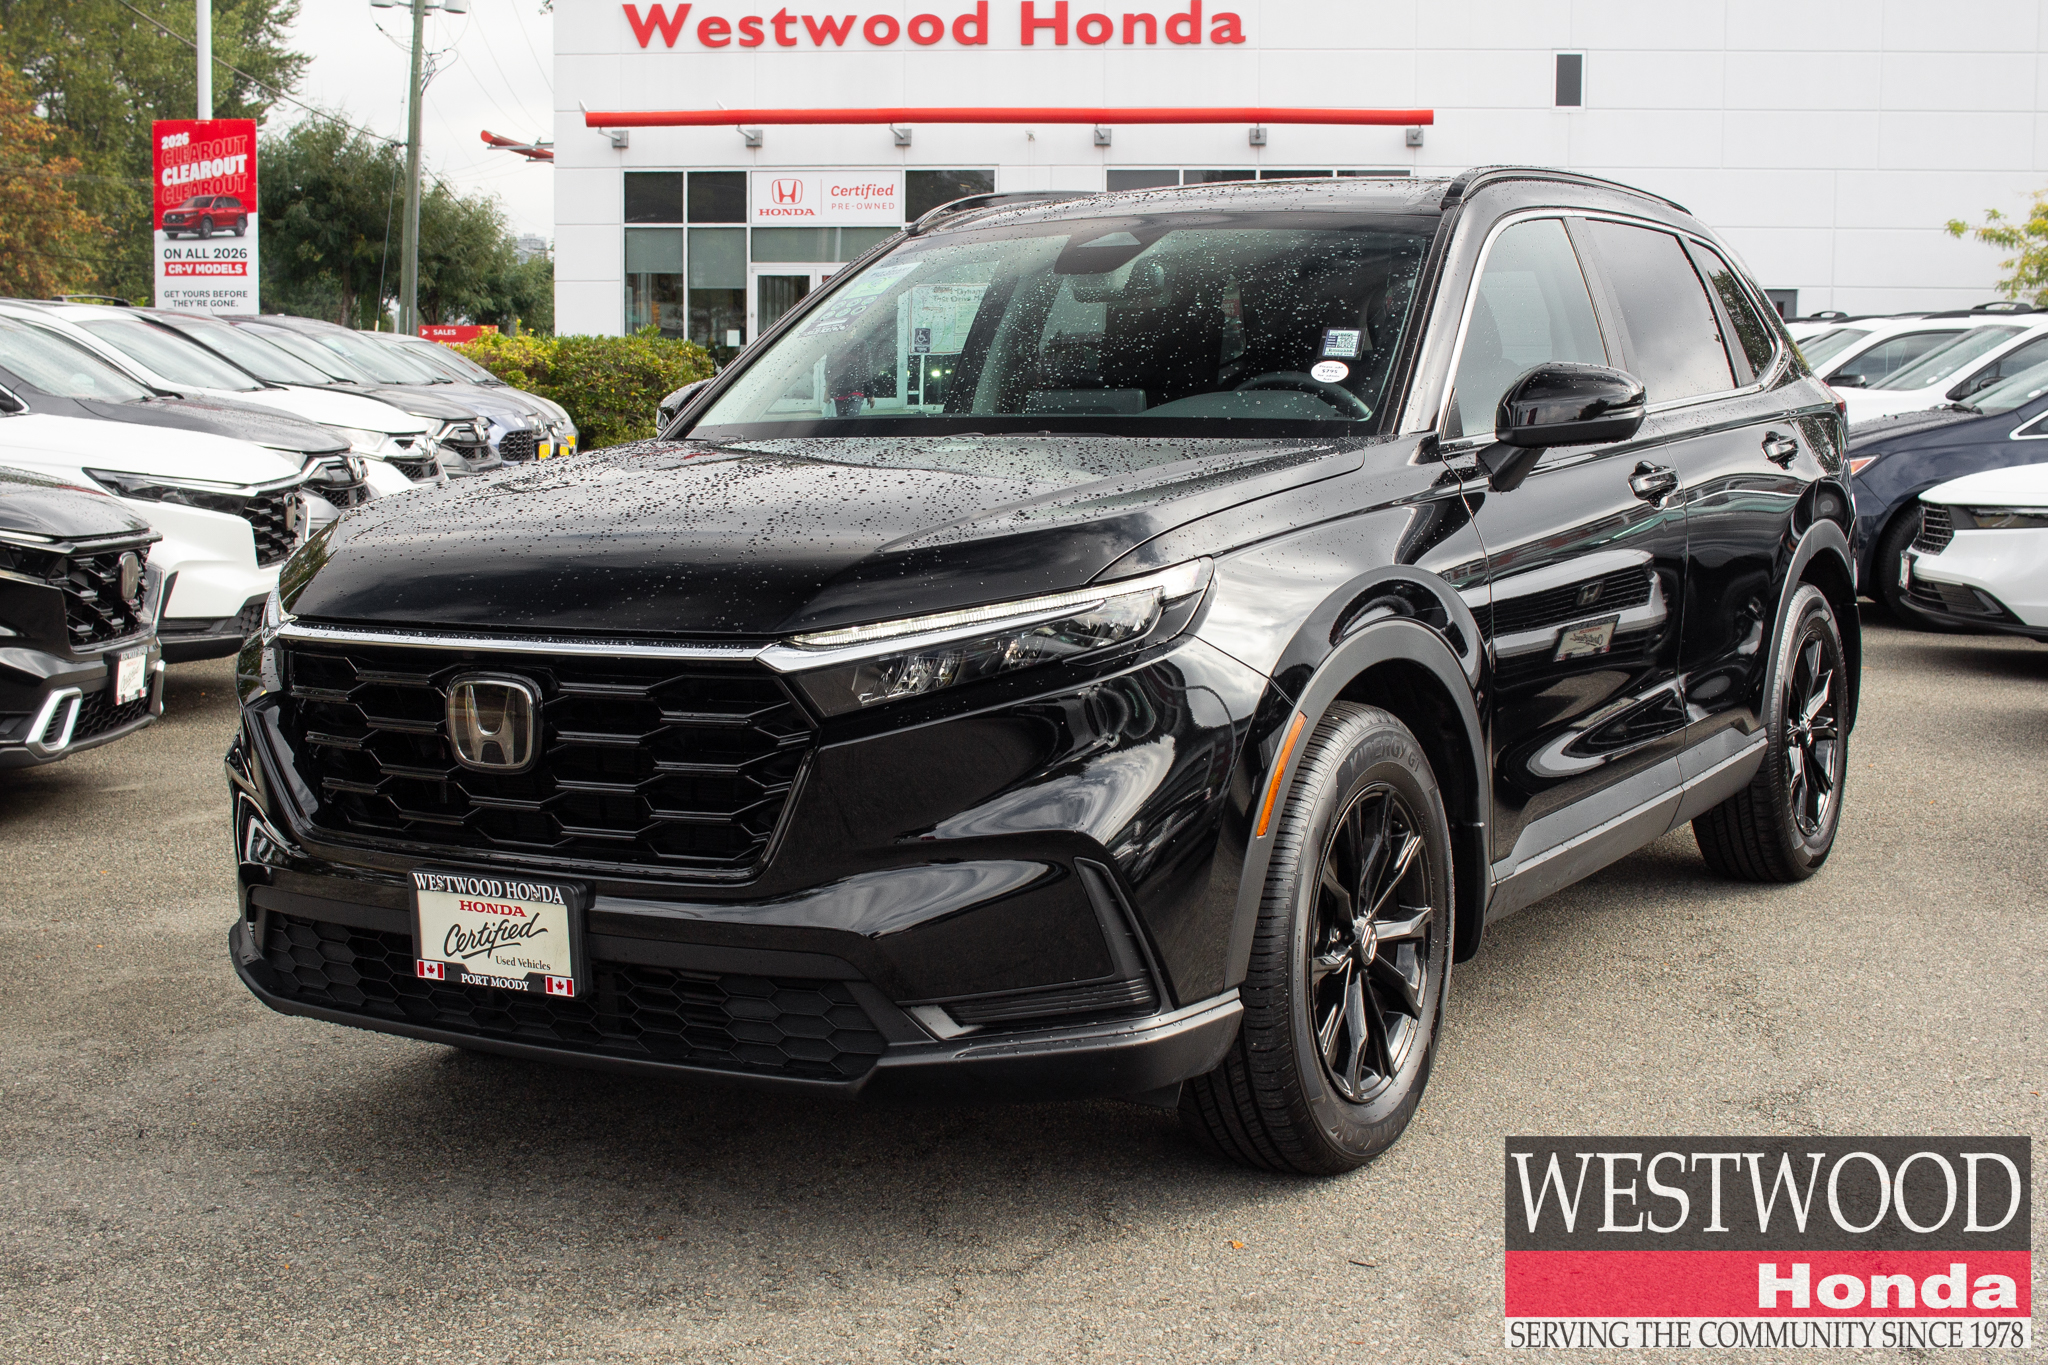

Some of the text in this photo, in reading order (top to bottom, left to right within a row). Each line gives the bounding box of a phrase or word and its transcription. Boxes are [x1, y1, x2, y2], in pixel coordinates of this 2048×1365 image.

[622, 0, 1246, 48] Westwood Honda
[161, 132, 190, 149] 2026
[161, 135, 247, 168] CLEAROUT
[162, 154, 248, 186] CLEAROUT
[162, 172, 248, 206] CLEAROUT
[831, 184, 895, 199] Certified
[758, 208, 816, 216] HONDA
[164, 248, 248, 259] ON ALL 2026
[168, 264, 243, 274] CR-V MODELS
[164, 290, 248, 298] GET YOURS BEFORE
[412, 873, 565, 905] WESTWOOD HONDA
[459, 900, 527, 917] HONDA
[444, 912, 549, 960] Certified
[495, 956, 551, 970] Used Vehicles
[461, 973, 530, 992] PORT MOODY
